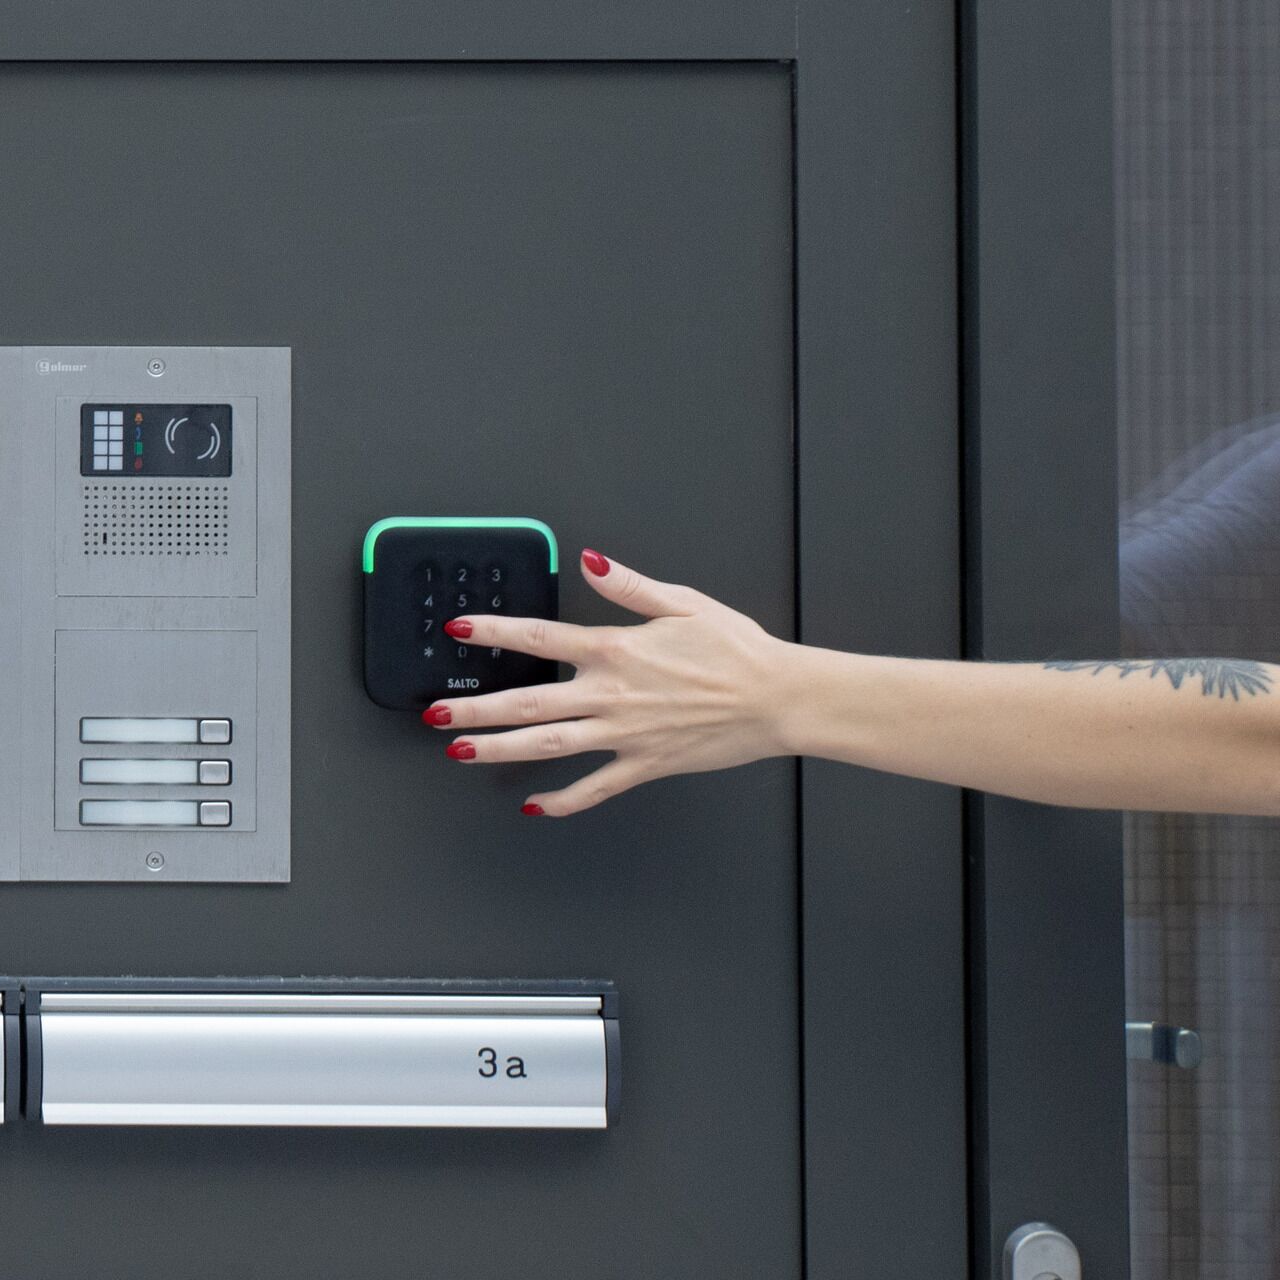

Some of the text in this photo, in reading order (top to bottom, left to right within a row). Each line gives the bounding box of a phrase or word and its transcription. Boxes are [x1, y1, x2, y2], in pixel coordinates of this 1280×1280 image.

[458, 568, 467, 582] 2
[491, 568, 501, 582] 3
[458, 594, 467, 607] 5
[492, 594, 501, 608] 6
[424, 619, 433, 633] 7
[447, 677, 480, 689] SALTO
[476, 1046, 529, 1080] 3a
